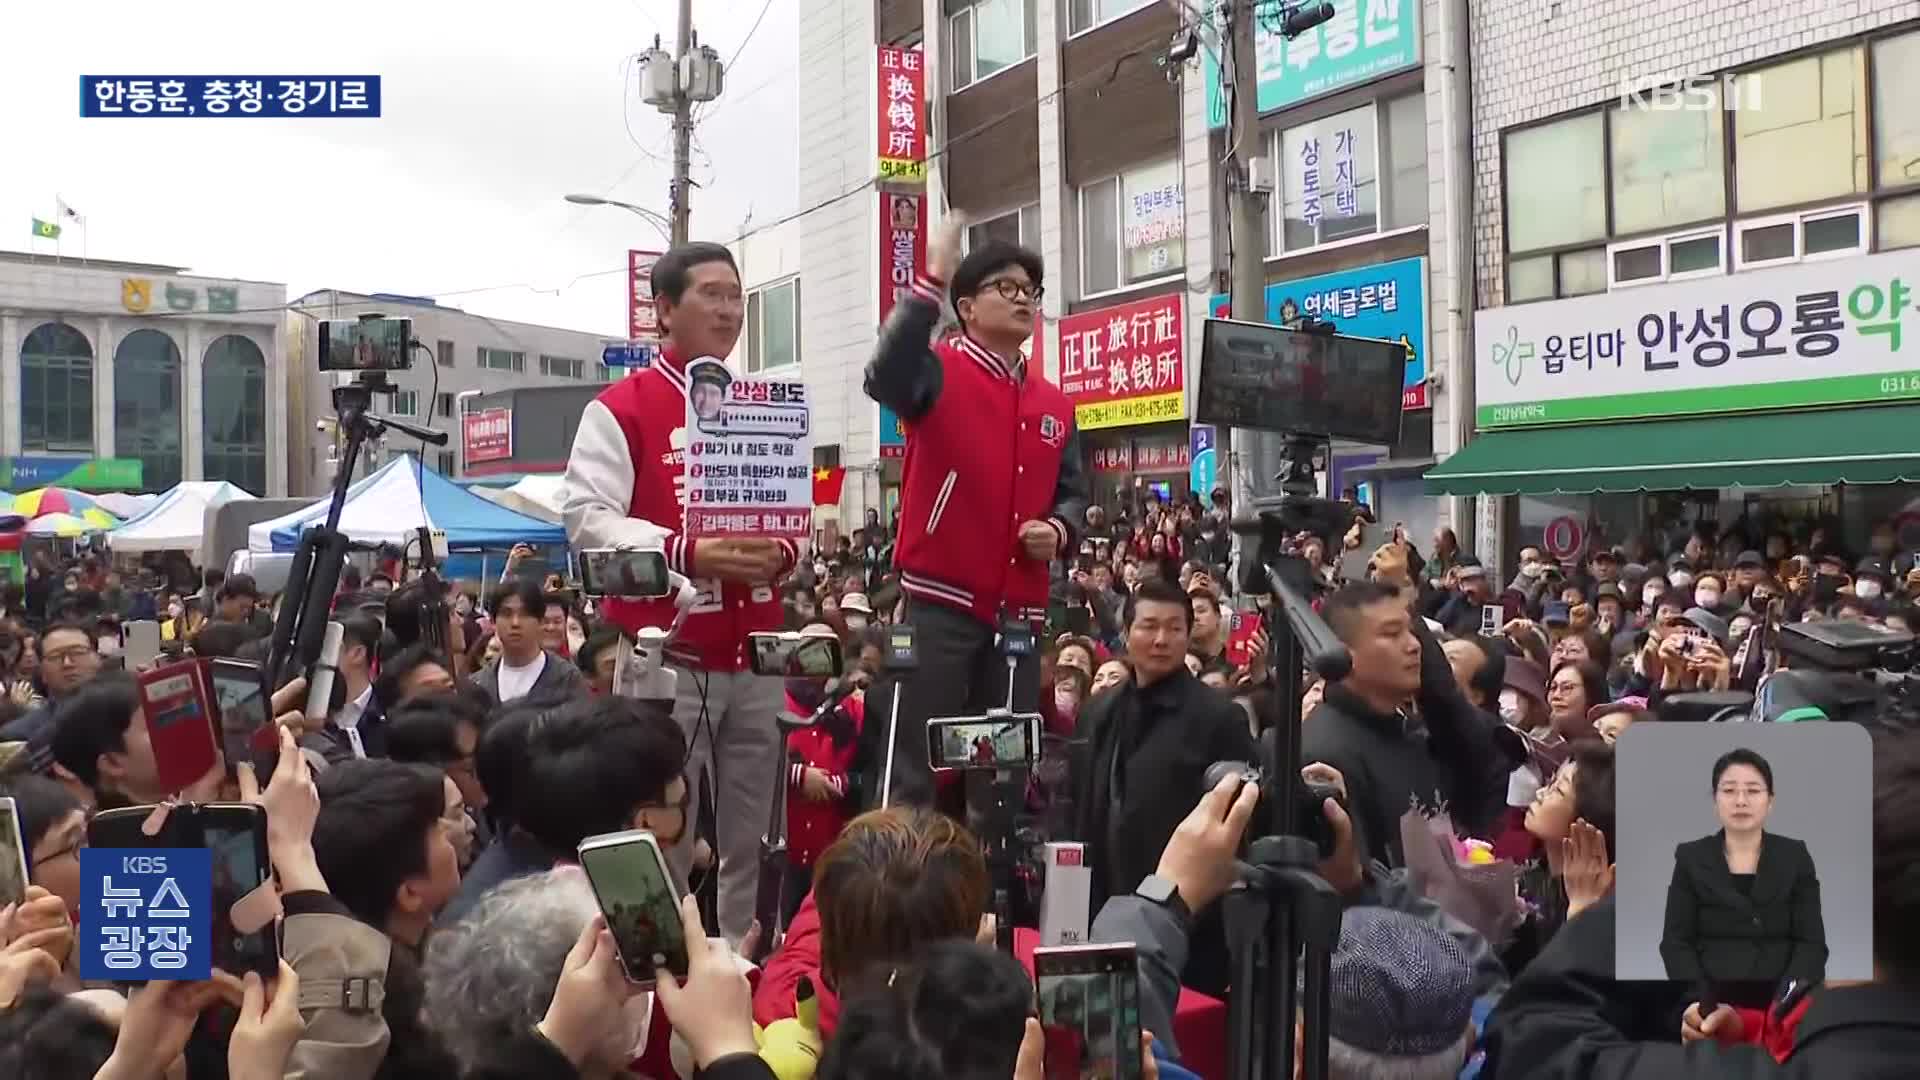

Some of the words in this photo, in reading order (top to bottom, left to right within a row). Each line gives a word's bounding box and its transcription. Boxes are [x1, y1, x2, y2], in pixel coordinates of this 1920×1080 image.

[886, 73, 916, 157] 换钱所
[165, 281, 239, 313] 농협
[1303, 279, 1398, 322] 연세글로벌
[1107, 306, 1177, 352] 旅行社
[1541, 328, 1626, 376] 옵티마
[1637, 277, 1920, 372] 안성오룡약
[1062, 327, 1104, 378] 正旺
[1108, 348, 1178, 395] 换钱所
[731, 381, 805, 402] 안성철도
